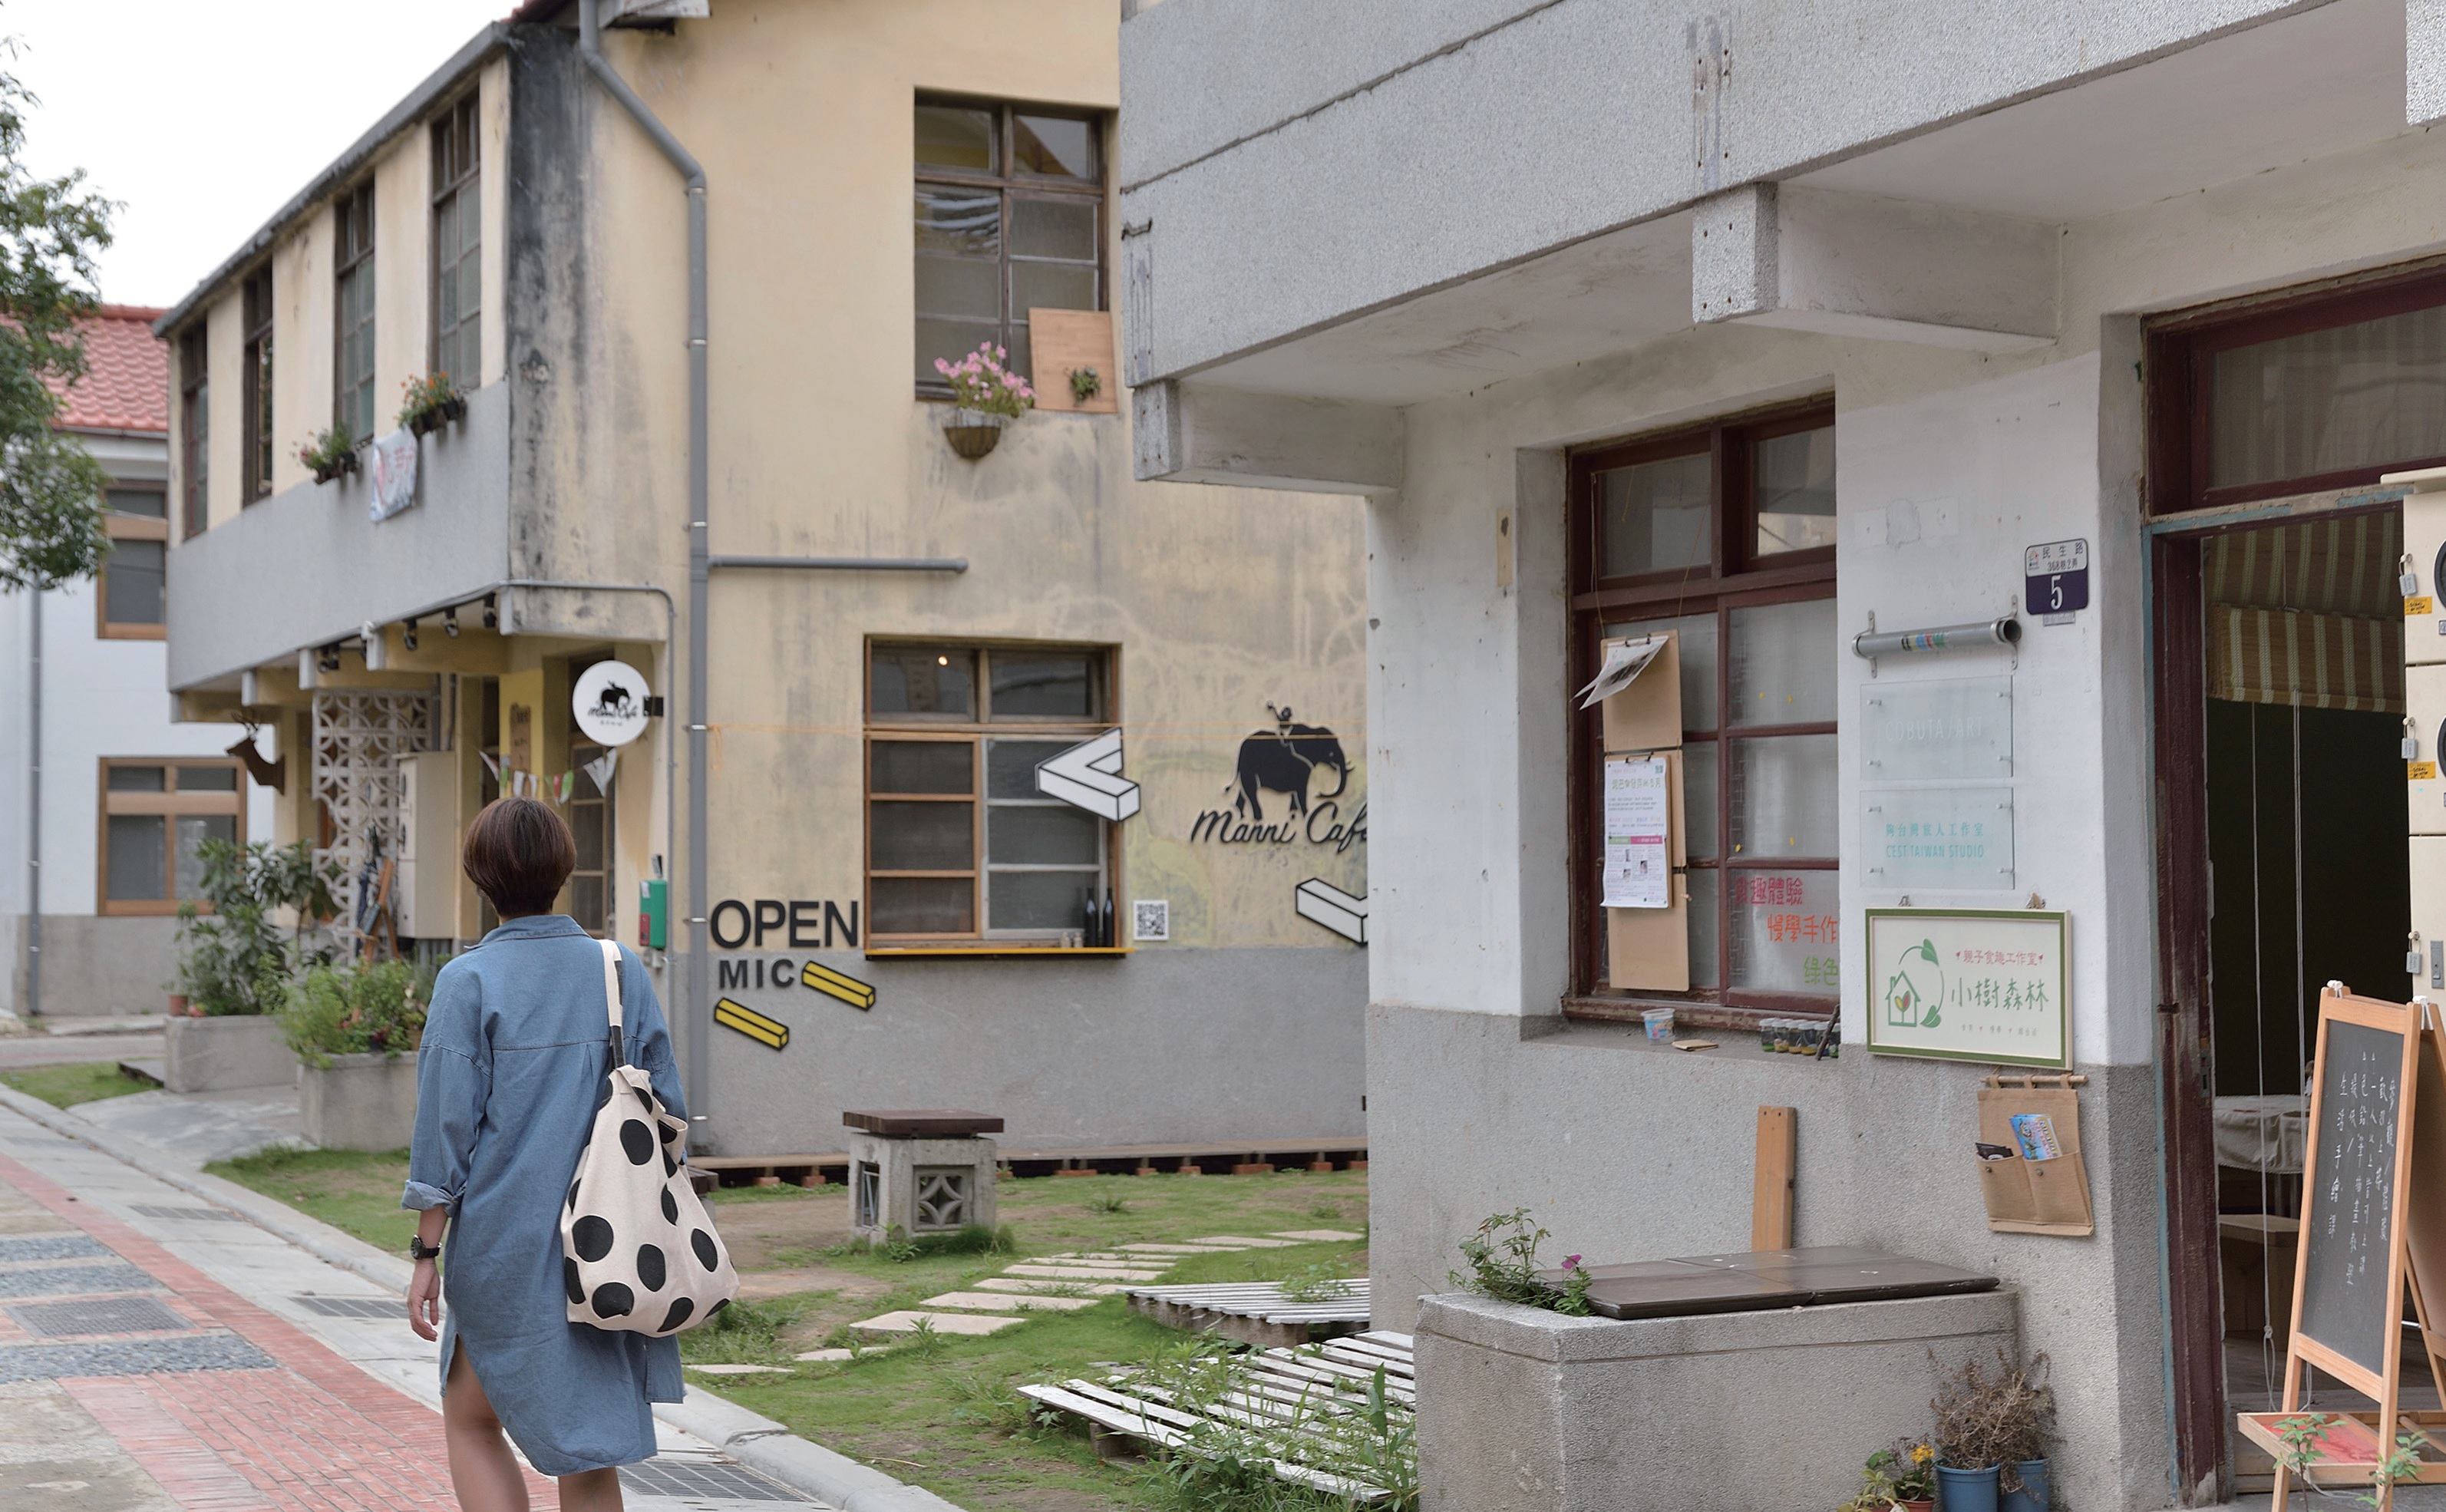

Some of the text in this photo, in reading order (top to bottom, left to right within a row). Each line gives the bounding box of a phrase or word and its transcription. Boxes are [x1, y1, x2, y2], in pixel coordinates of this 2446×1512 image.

[2042, 541, 2084, 560] 民生路
[2050, 574, 2064, 611] 5
[1190, 808, 1297, 843] Manni
[1910, 844, 1945, 858] TAIWAN
[1949, 844, 1984, 858] STUDIO
[711, 900, 858, 949] OPEN
[1767, 913, 1838, 944] 慢學手作
[1804, 956, 1839, 986] 綠色
[1963, 950, 2038, 966] 親子食趣工作室
[718, 959, 795, 989] MIC
[1950, 977, 2049, 1012] 小樹森林
